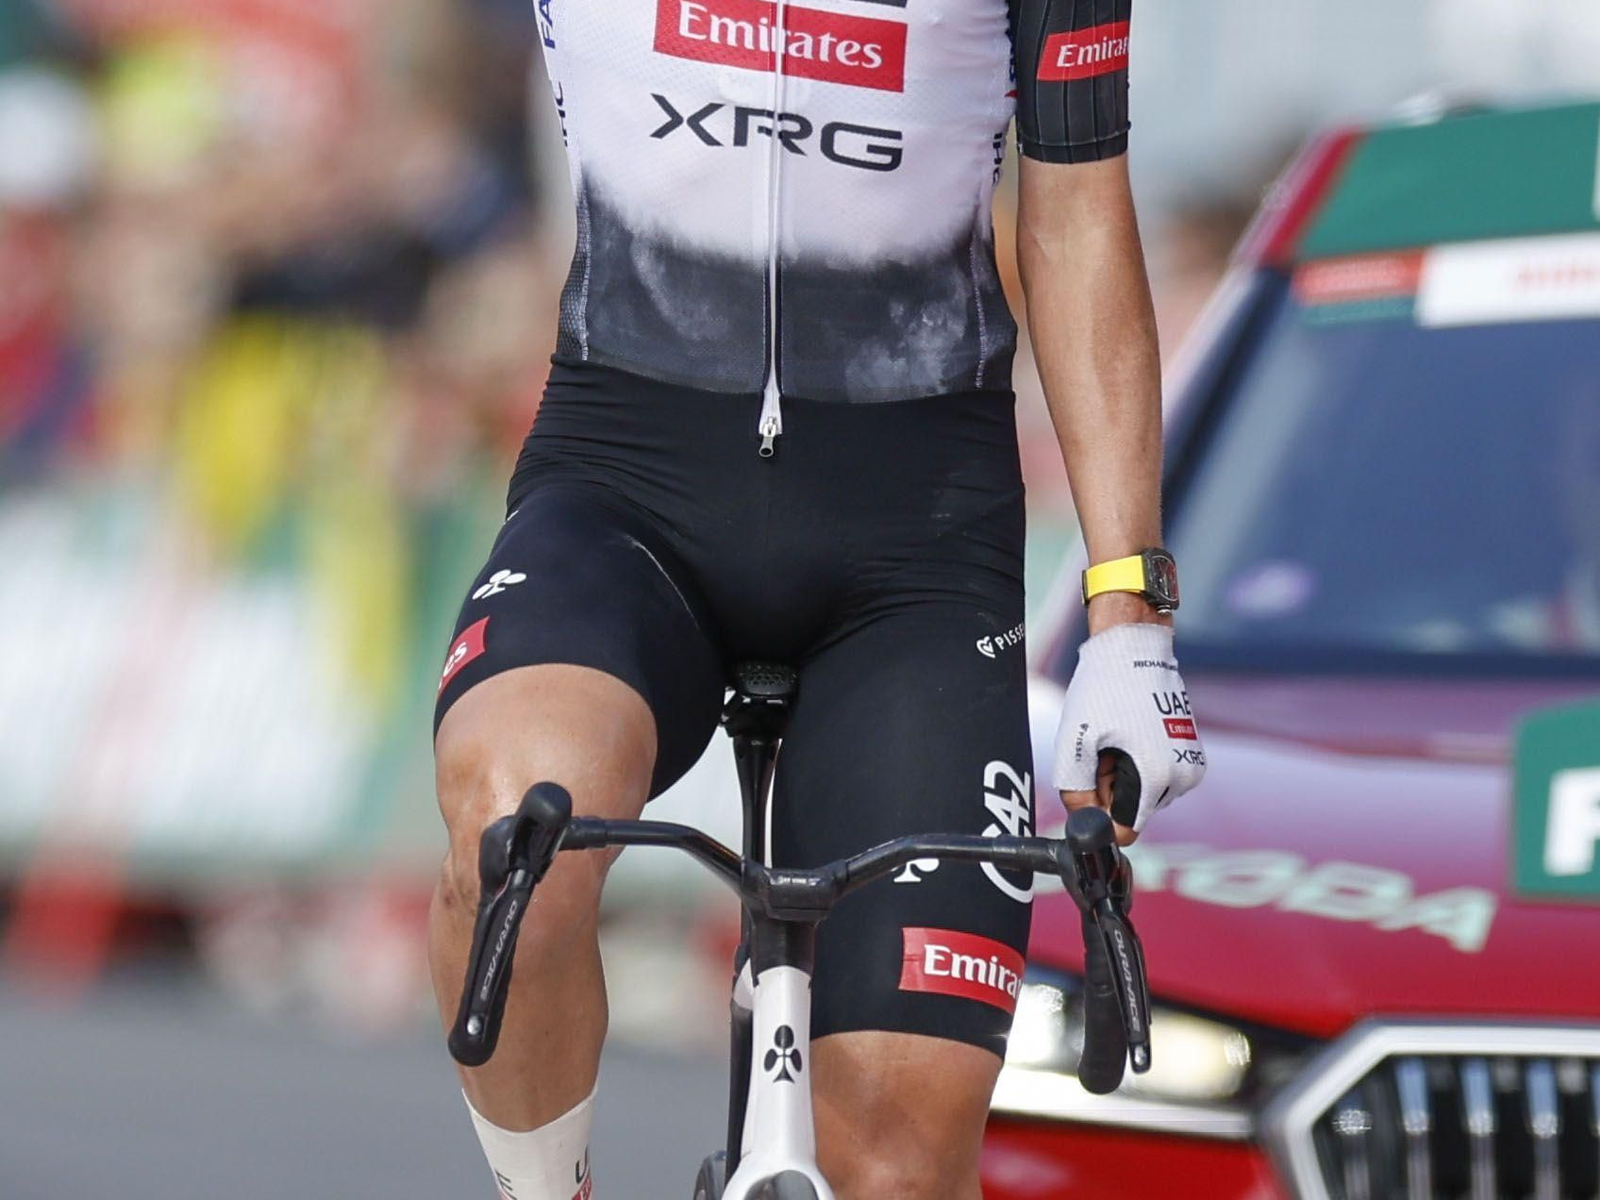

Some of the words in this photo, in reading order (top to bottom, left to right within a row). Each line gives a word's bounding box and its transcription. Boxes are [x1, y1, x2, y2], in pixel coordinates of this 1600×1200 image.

[679, 0, 883, 69] Emirates
[649, 93, 903, 172] XRG
[1152, 692, 1191, 716] UAE
[924, 944, 1022, 999] Emira
